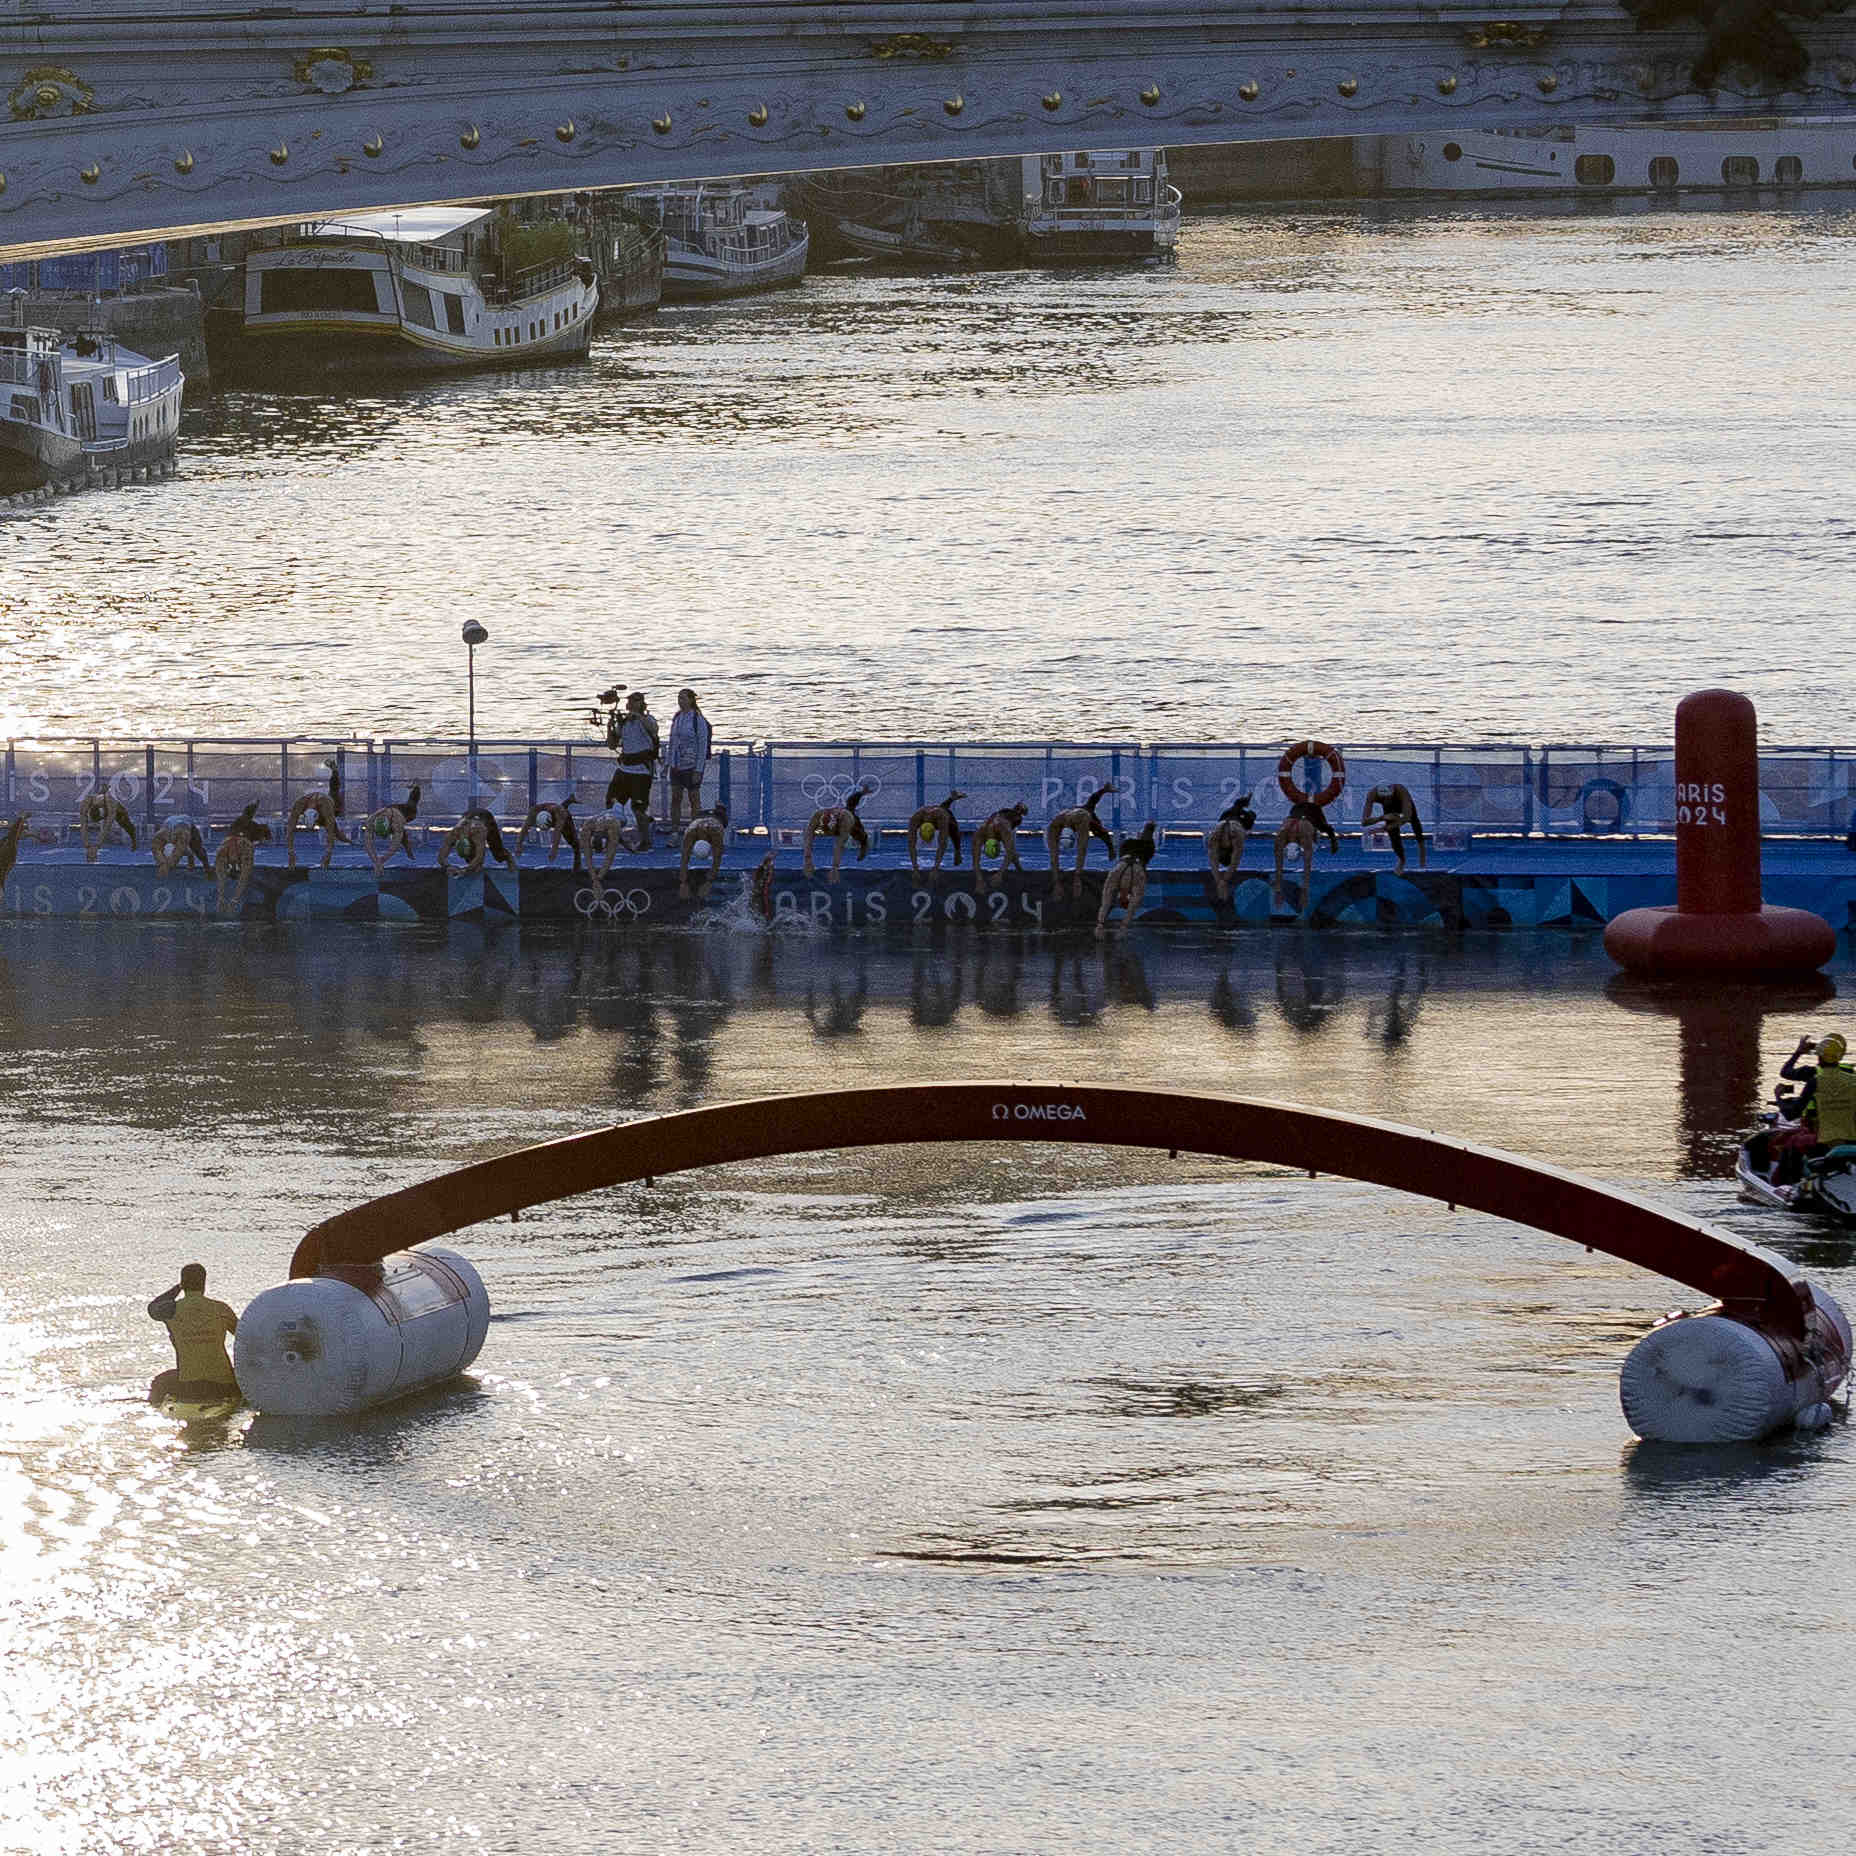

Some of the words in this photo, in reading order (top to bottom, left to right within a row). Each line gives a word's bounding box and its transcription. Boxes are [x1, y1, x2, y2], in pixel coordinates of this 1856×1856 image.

[75, 770, 208, 804] 2024
[912, 892, 1044, 922] 2024
[1014, 1104, 1087, 1120] OMEGA
